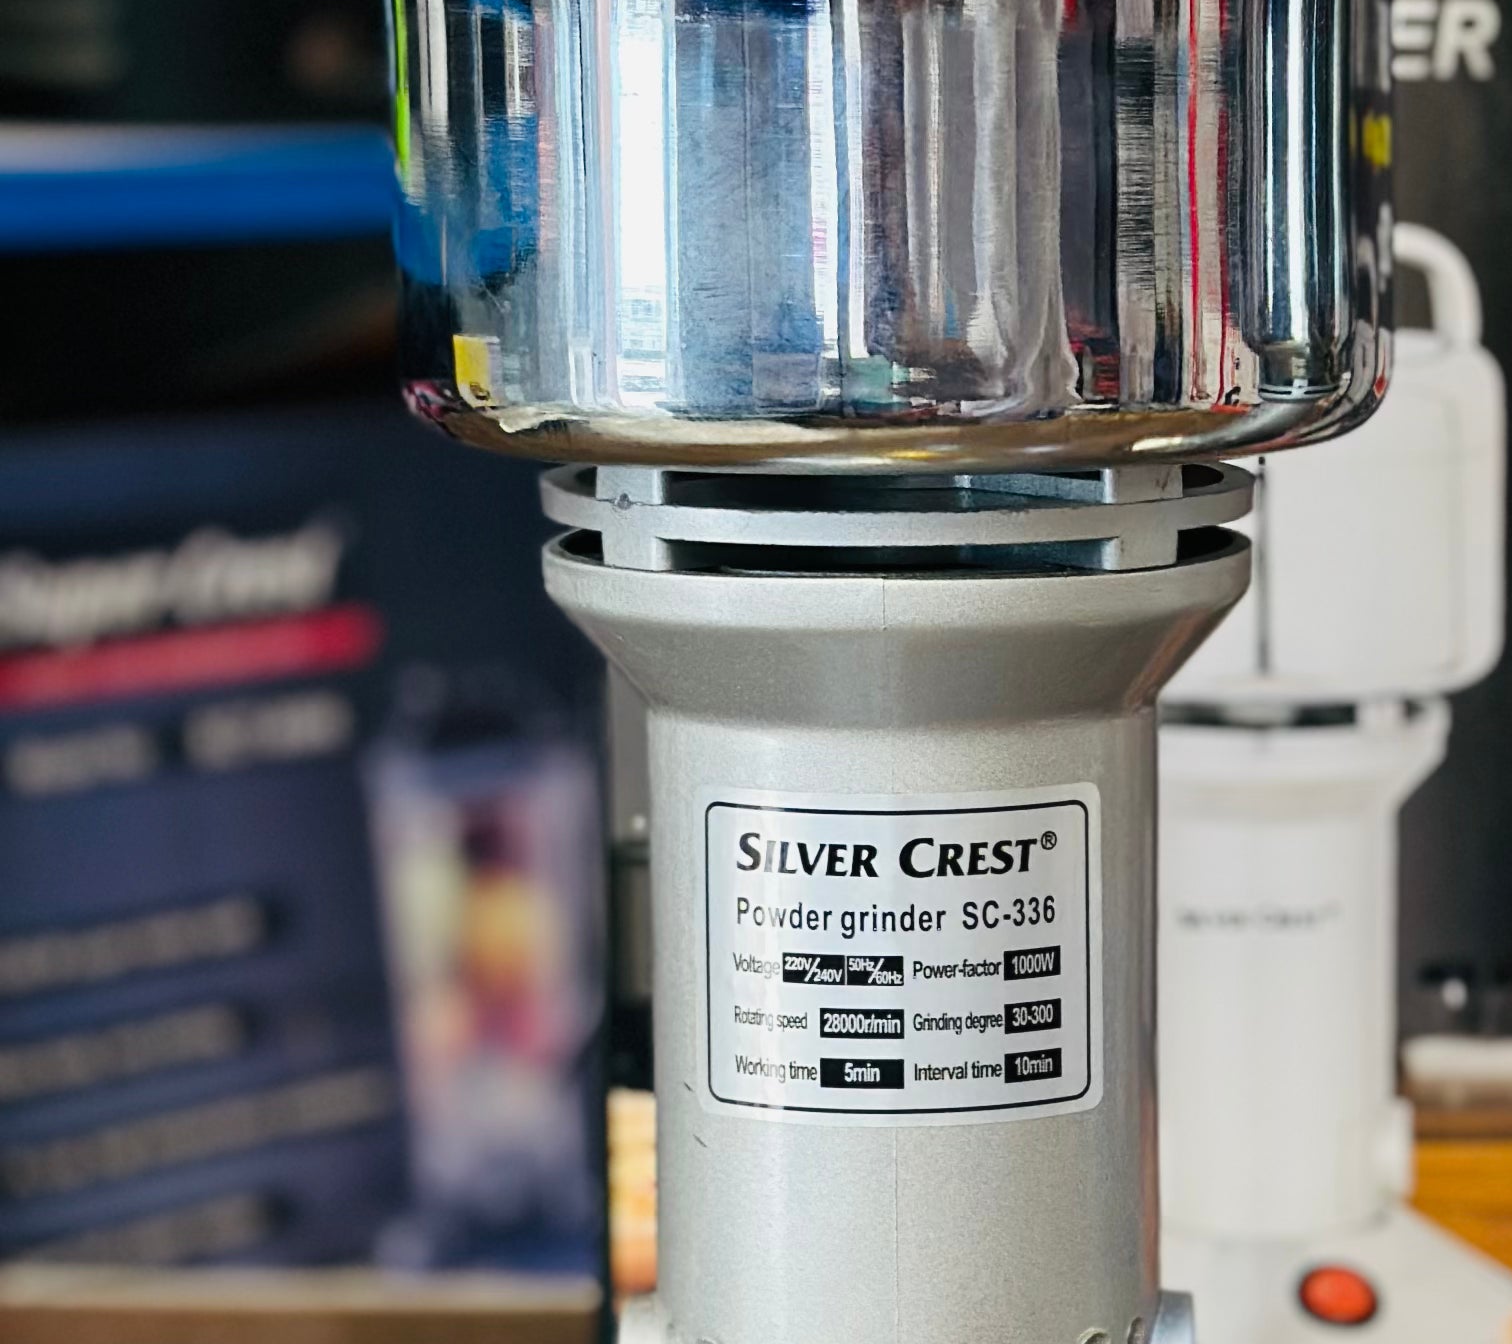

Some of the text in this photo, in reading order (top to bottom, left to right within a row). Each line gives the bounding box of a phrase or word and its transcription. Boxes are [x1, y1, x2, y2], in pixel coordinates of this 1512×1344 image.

[736, 831, 880, 878] SILVER
[736, 895, 1056, 939] Powder grinder SC-336
[732, 951, 781, 978] Voltage
[912, 958, 1002, 981] Power-factor
[1011, 951, 1055, 975] 1000W
[734, 1004, 1054, 1035] Rotating speed 28000r/min Grinding degree 30-300
[734, 1053, 1054, 1082] Working time 5min Interval time 10min
